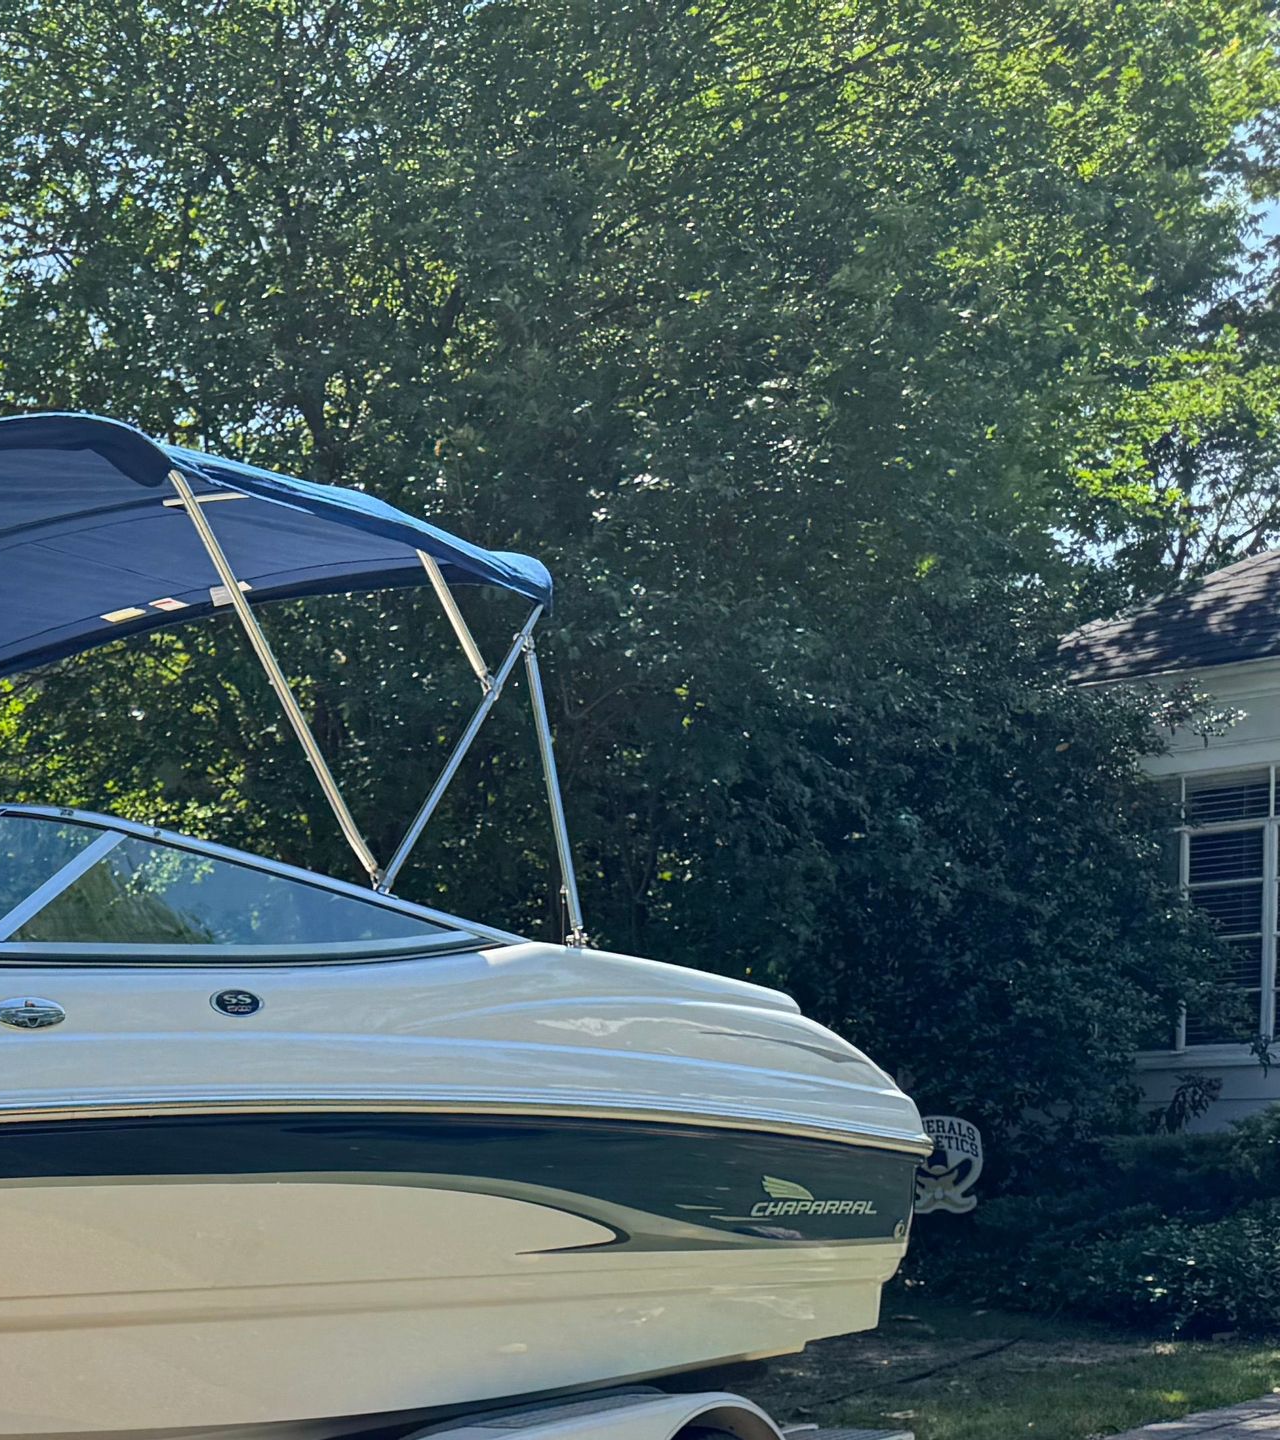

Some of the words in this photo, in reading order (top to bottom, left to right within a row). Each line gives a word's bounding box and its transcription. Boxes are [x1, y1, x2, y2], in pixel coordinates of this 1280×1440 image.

[222, 994, 252, 1005] SS
[922, 1119, 976, 1142] ERALS
[934, 1134, 979, 1157] ETICS
[750, 1200, 877, 1217] CHAPARRAL
